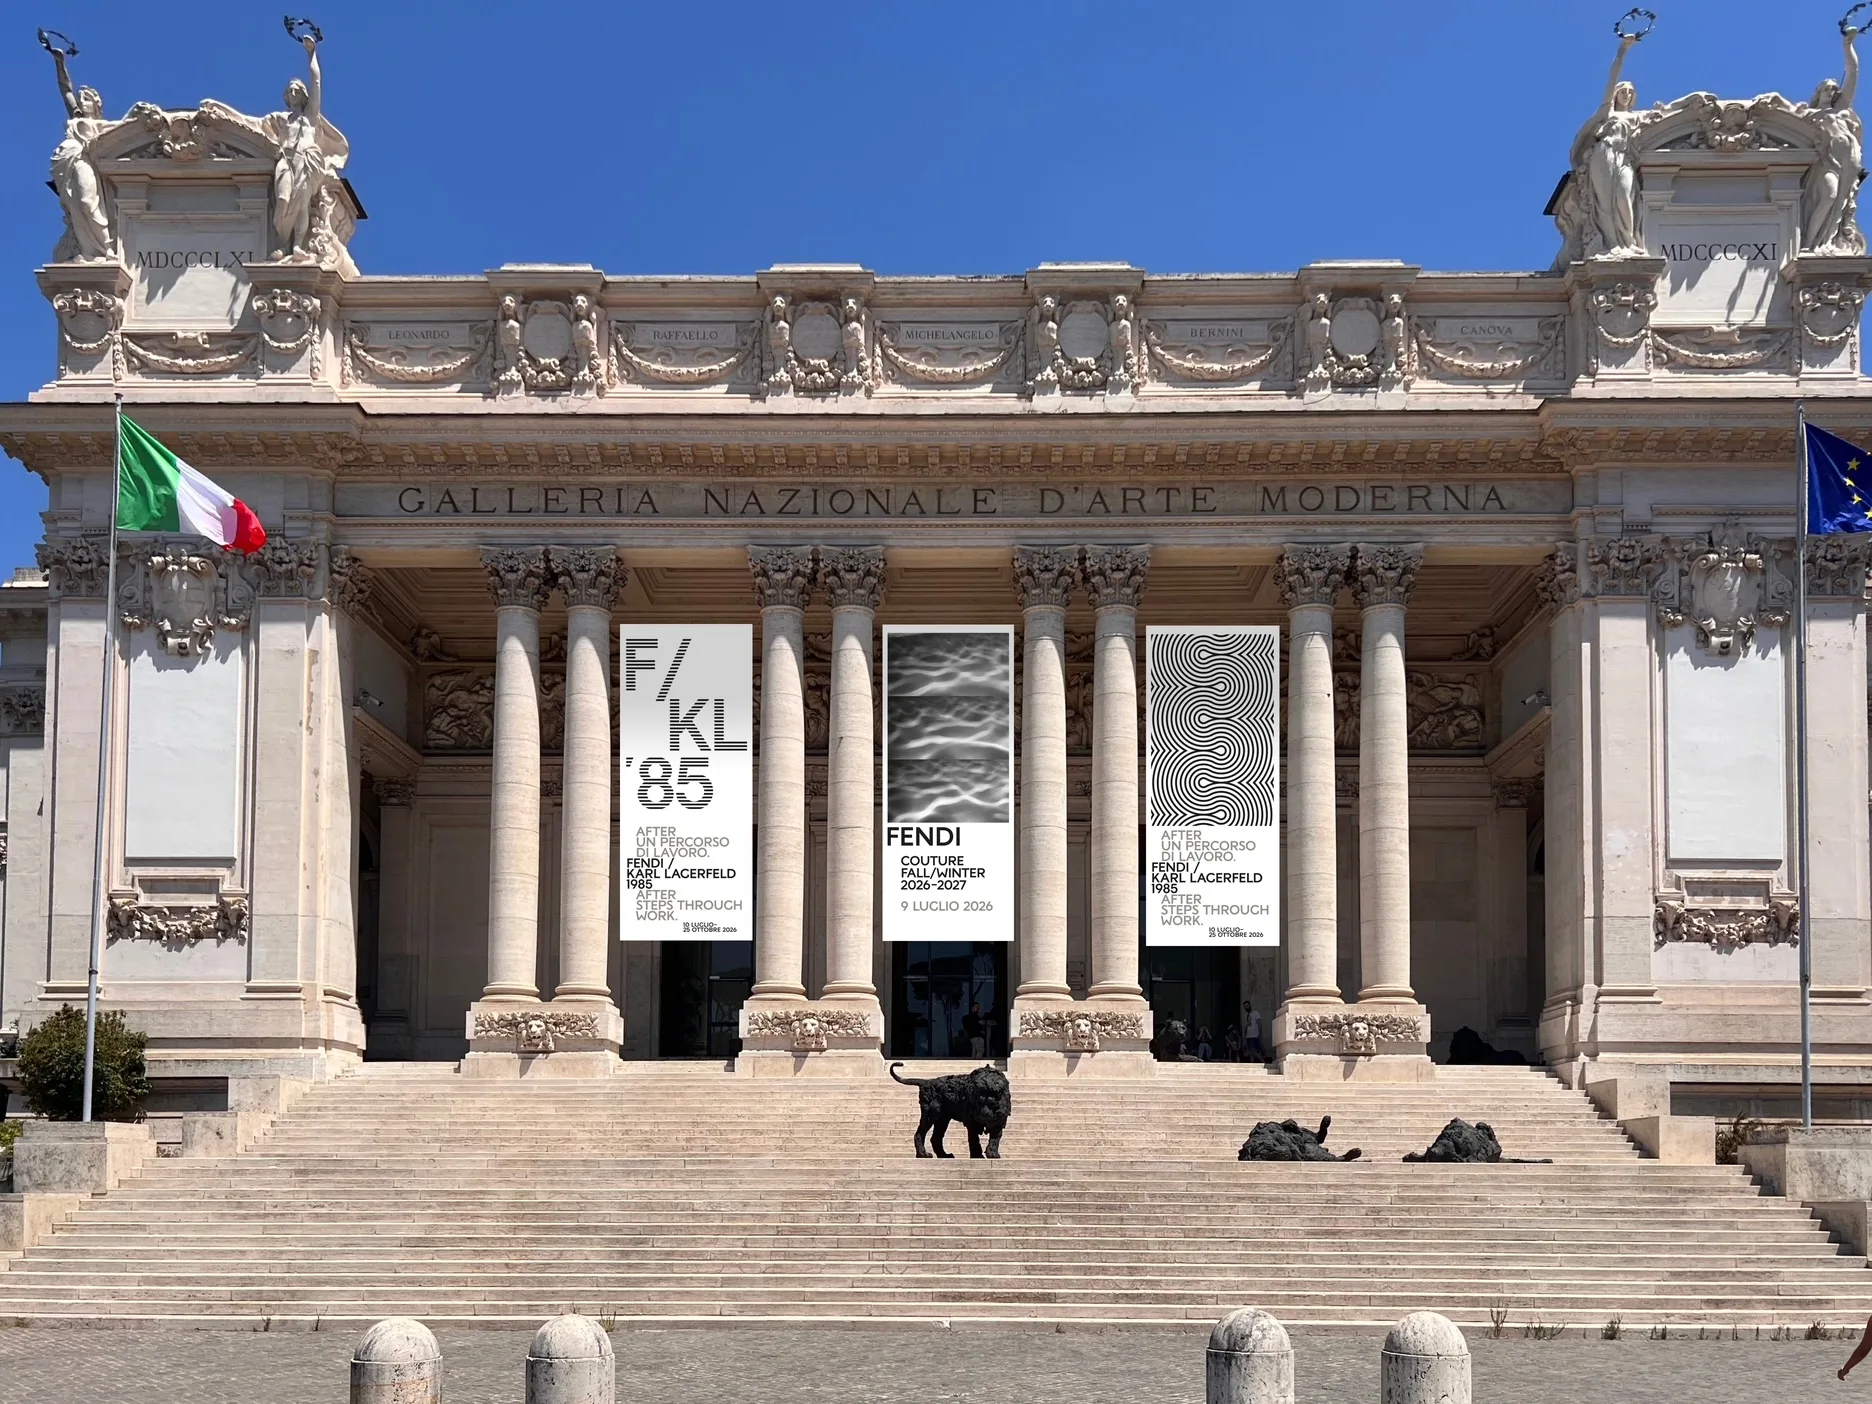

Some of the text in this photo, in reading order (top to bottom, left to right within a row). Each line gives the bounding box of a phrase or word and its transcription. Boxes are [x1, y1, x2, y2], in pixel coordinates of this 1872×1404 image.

[1660, 243, 1777, 262] MDCCCCXI
[136, 251, 254, 269] MDCCCLXI
[388, 329, 451, 341] LEONARDO
[904, 329, 995, 341] MICHELANGELO
[1190, 327, 1245, 339] BERNINI
[1460, 325, 1513, 335] CANOVA
[652, 330, 719, 341] RAFFAELLO
[398, 485, 1508, 515] GALLERIA NAZIONALE D'ARTE MODERNA
[670, 699, 747, 751] KL
[636, 827, 676, 836] AFTER
[888, 827, 960, 846] FENDI
[1161, 830, 1201, 840] AFTER
[637, 837, 729, 847] UN PERCORSO
[1162, 841, 1256, 851] UN PERCORSO
[637, 848, 709, 858] DI LAVORO.
[1162, 852, 1235, 862] DI LAVORO.
[627, 858, 674, 869] FENDI /
[901, 856, 963, 866] COUTURE
[1152, 862, 1200, 873] FENDI /
[627, 869, 736, 878] KARL LAGERFELD
[901, 867, 985, 879] FALL/WINTER
[1152, 873, 1262, 883] KARL LAGERFELD
[626, 879, 652, 889] 1985
[901, 880, 966, 890] 2026-2027
[1151, 884, 1178, 893] 1985
[636, 890, 676, 899] AFTER
[1161, 894, 1201, 904] AFTER
[636, 900, 742, 910] STEPS THROUGH
[901, 901, 993, 911] 9 LUGLIO 2026
[1162, 905, 1268, 915] STEPS THROUGH
[636, 911, 677, 920] WORK.
[1161, 916, 1203, 925] WORK.
